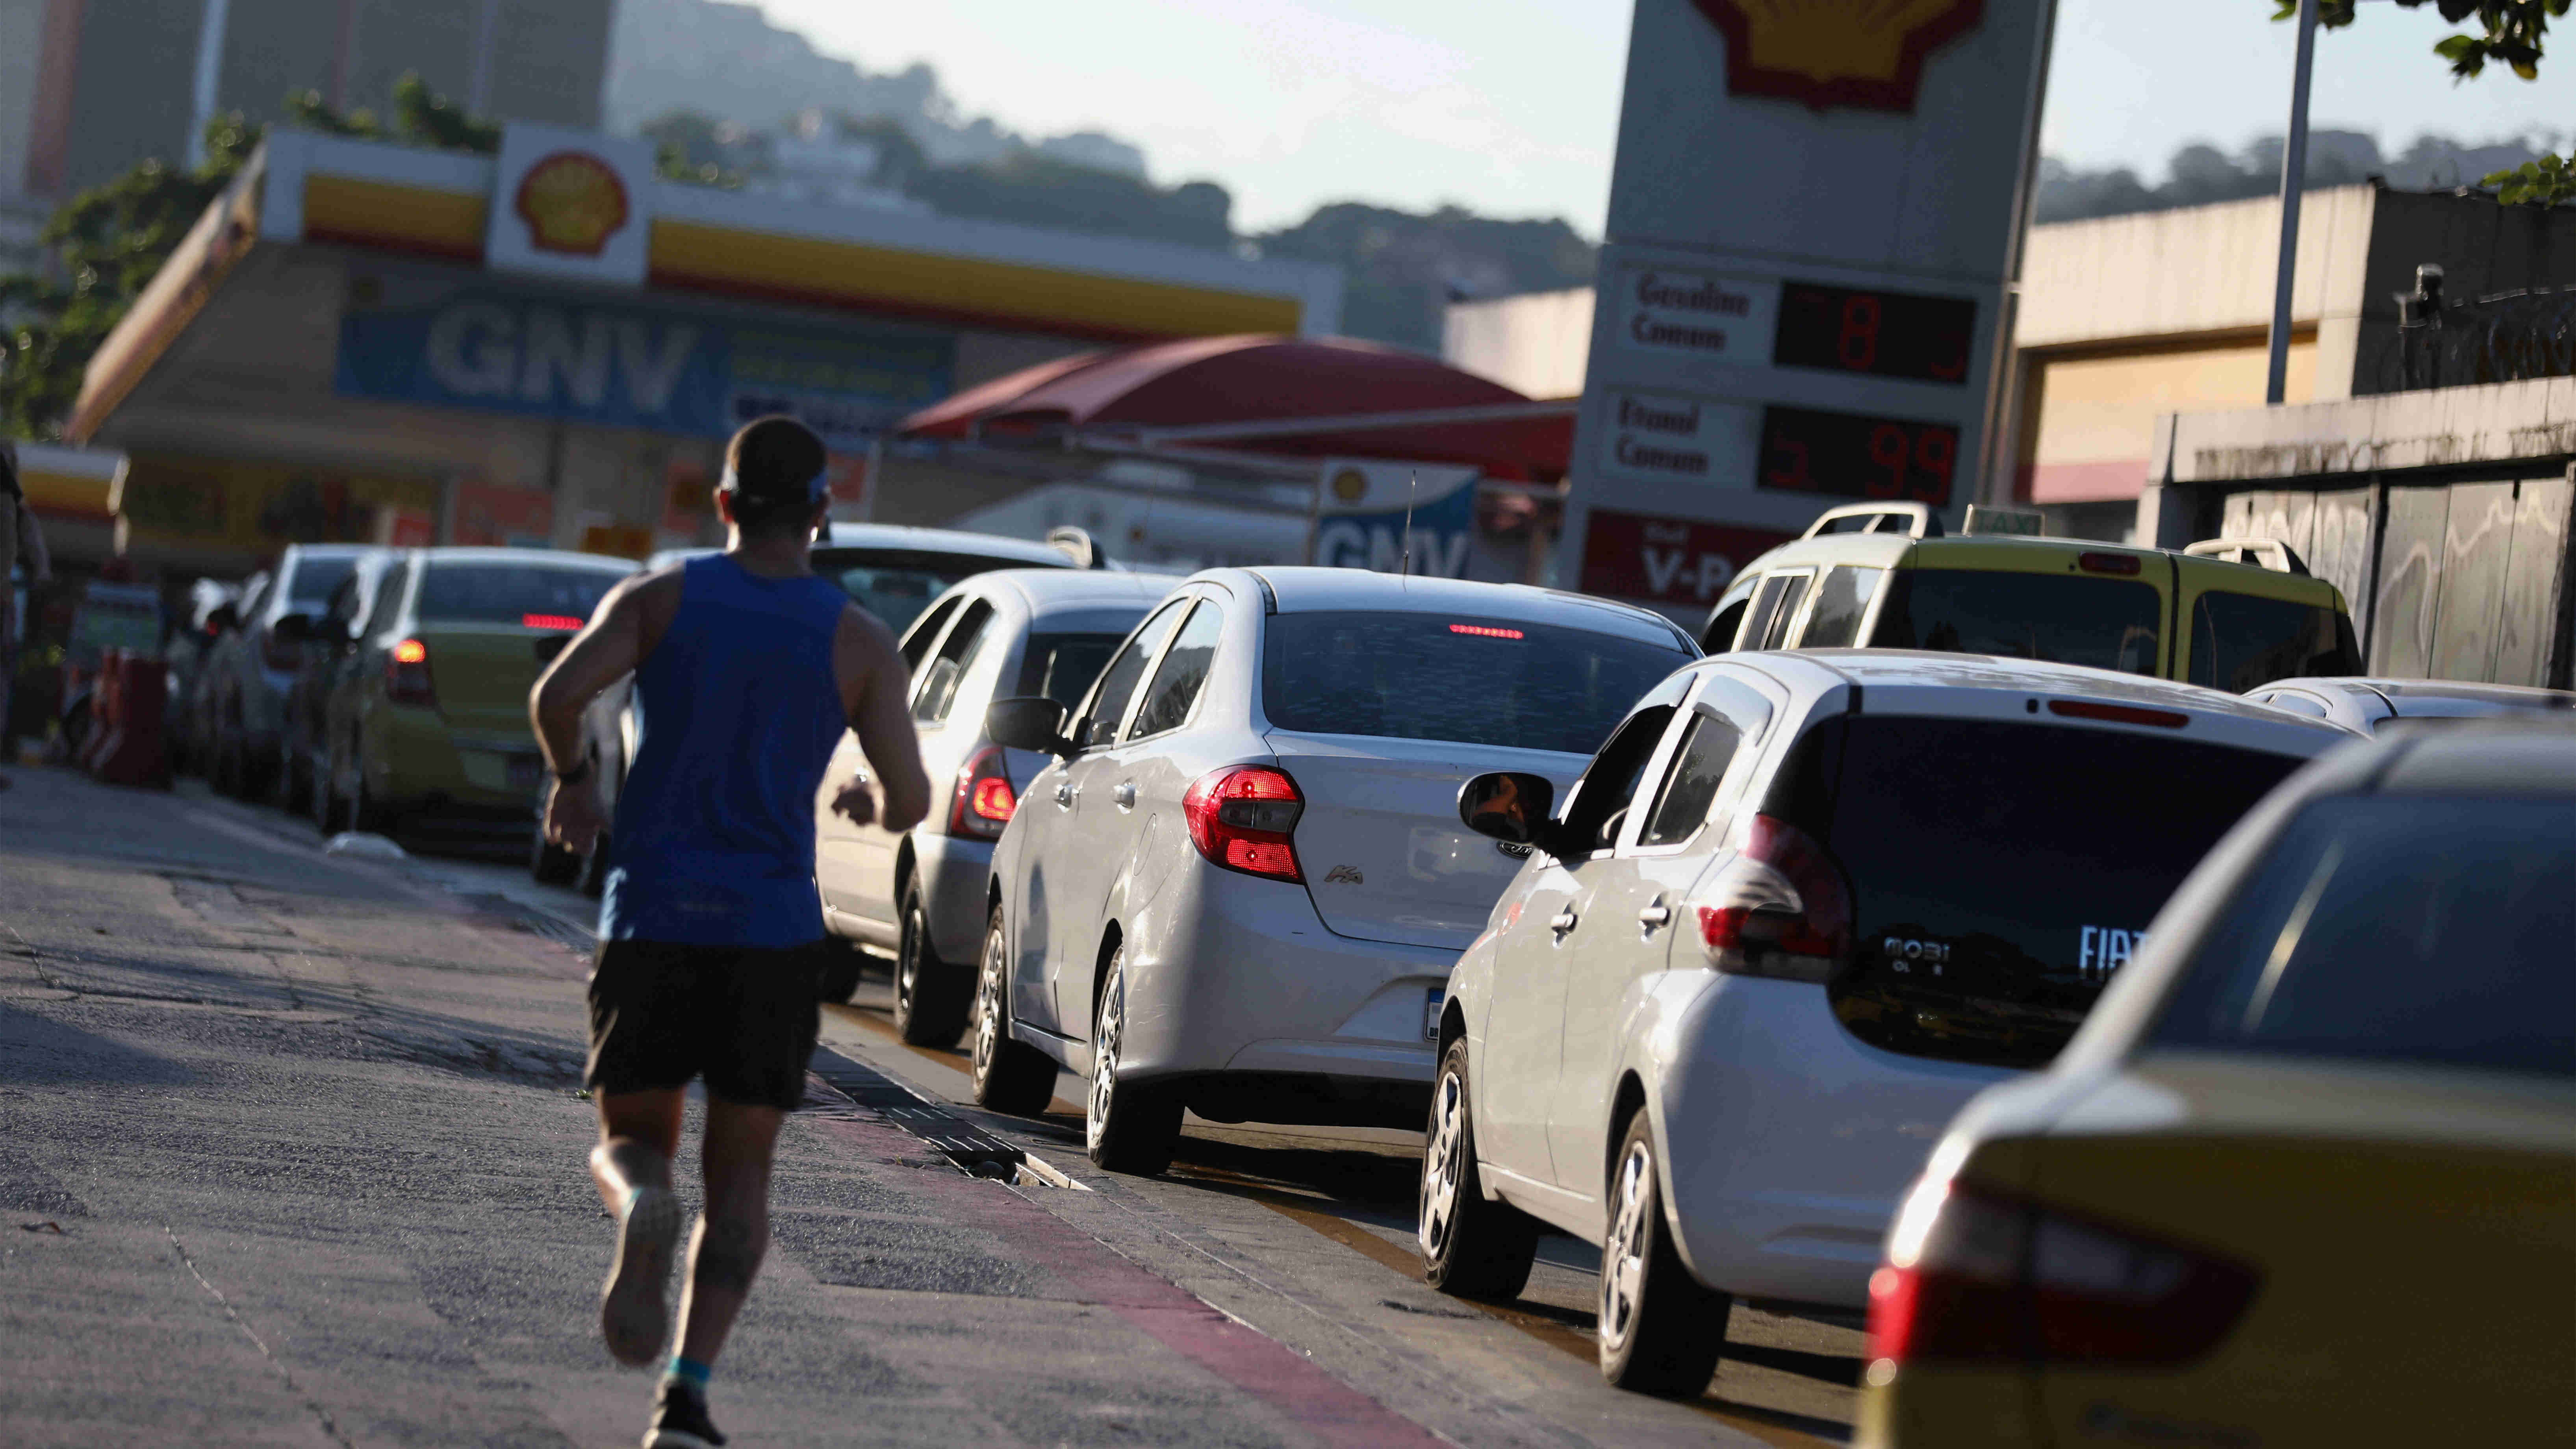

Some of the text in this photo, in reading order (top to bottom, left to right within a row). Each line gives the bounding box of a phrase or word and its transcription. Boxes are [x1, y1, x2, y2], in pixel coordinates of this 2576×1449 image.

[1630, 311, 1727, 353] Comum
[426, 301, 699, 413] GNV
[1617, 395, 1701, 438] Etanol
[1615, 433, 1710, 475] Comum
[1976, 510, 2039, 535] TAXI
[1316, 521, 1469, 580] GNV
